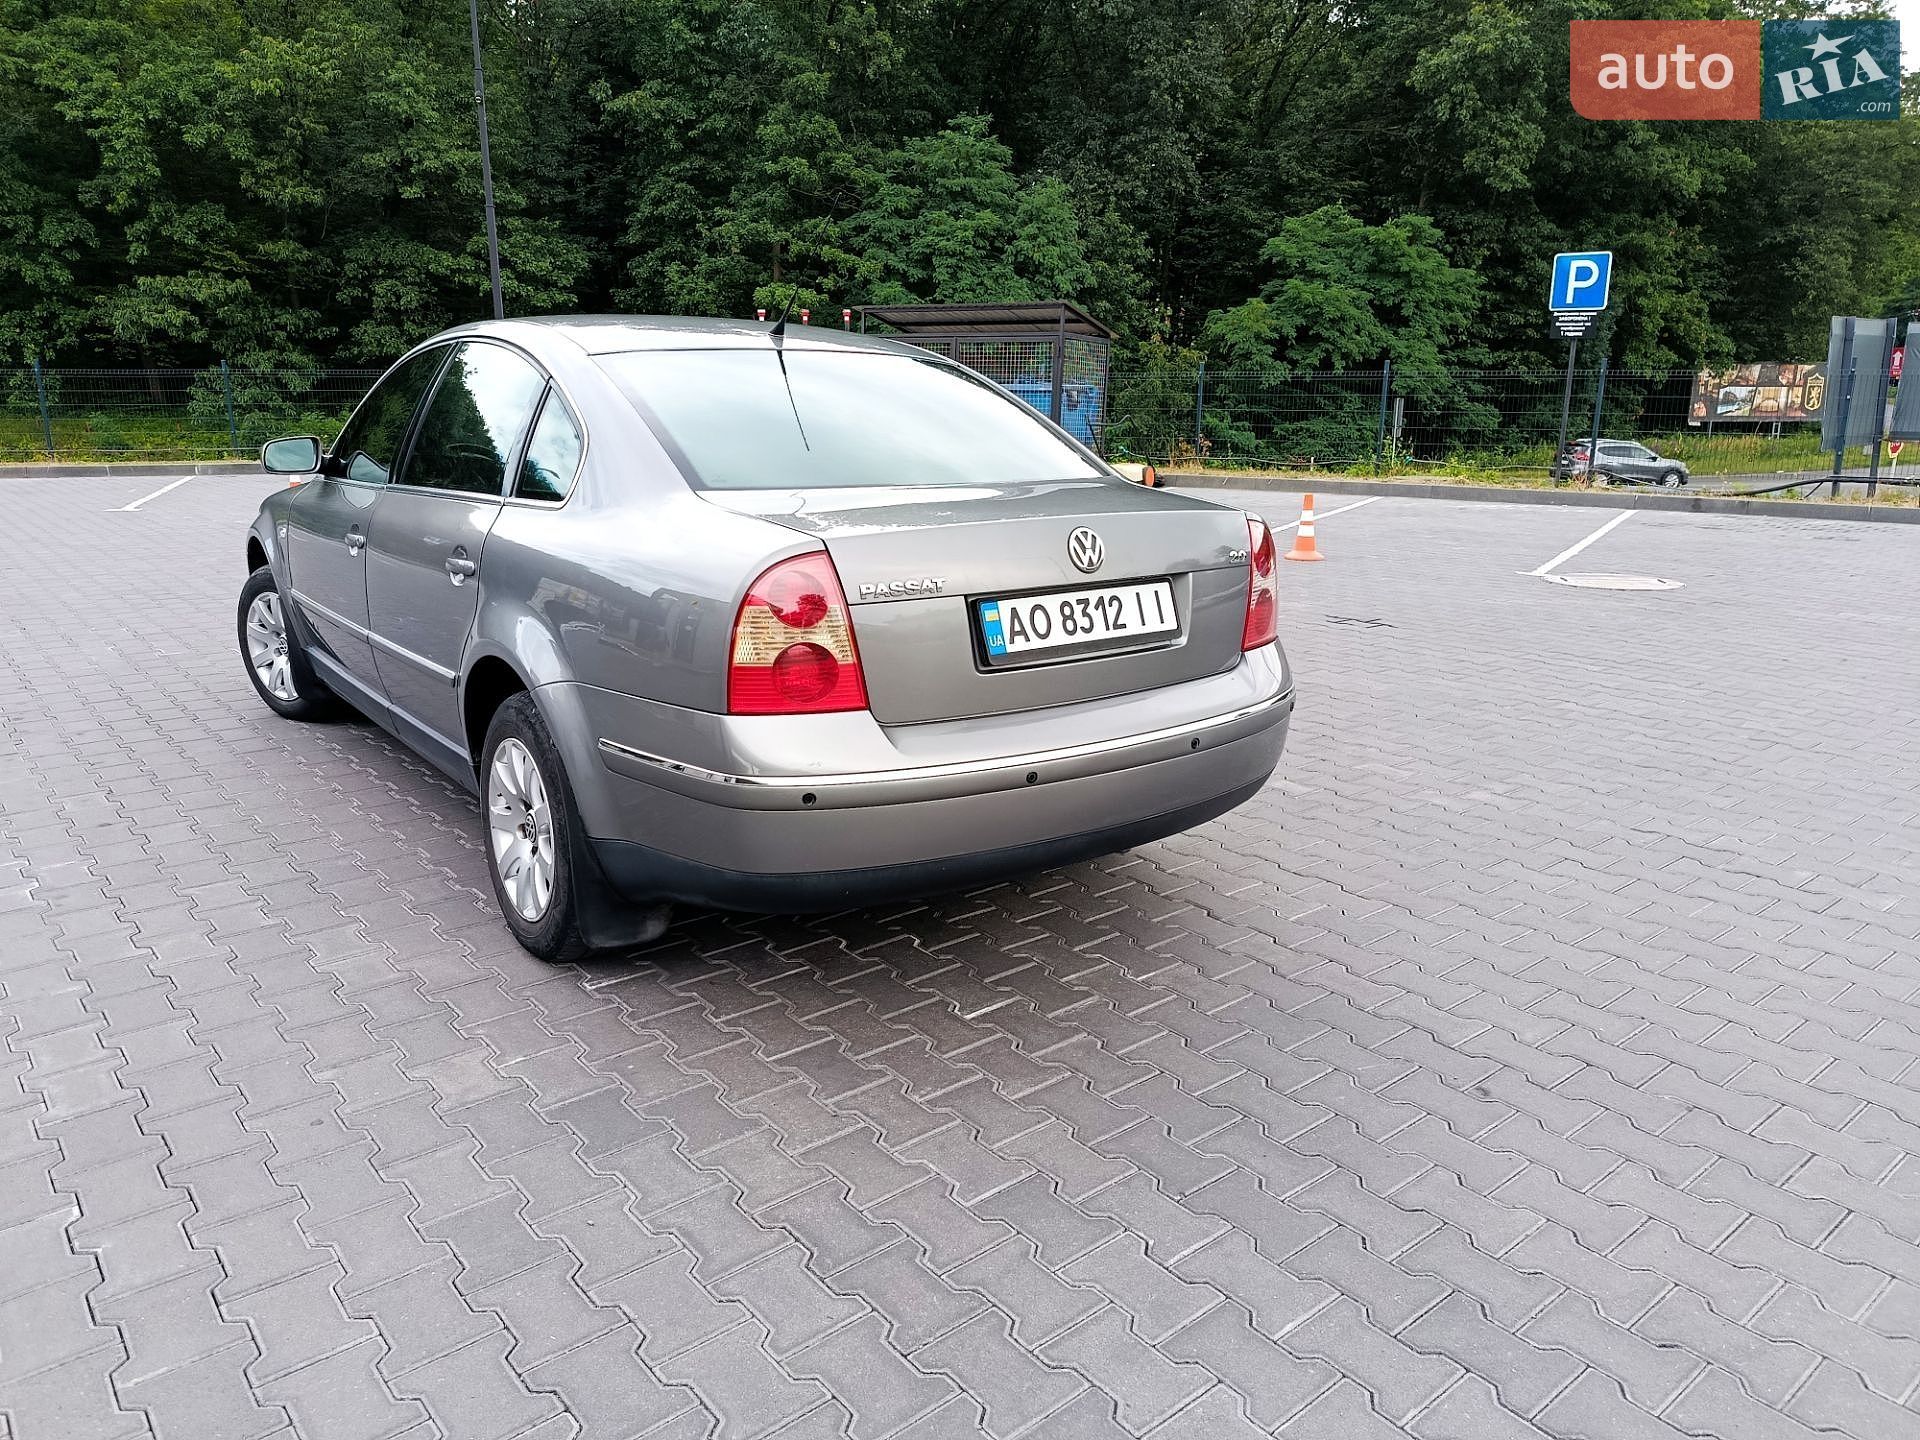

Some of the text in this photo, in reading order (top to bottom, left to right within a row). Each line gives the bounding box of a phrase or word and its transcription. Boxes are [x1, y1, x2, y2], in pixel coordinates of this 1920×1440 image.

[1566, 259, 1600, 304] P
[859, 577, 947, 600] PASSAT
[1009, 603, 1052, 645] AO
[1059, 595, 1127, 636] 8312
[989, 635, 1004, 647] UA
